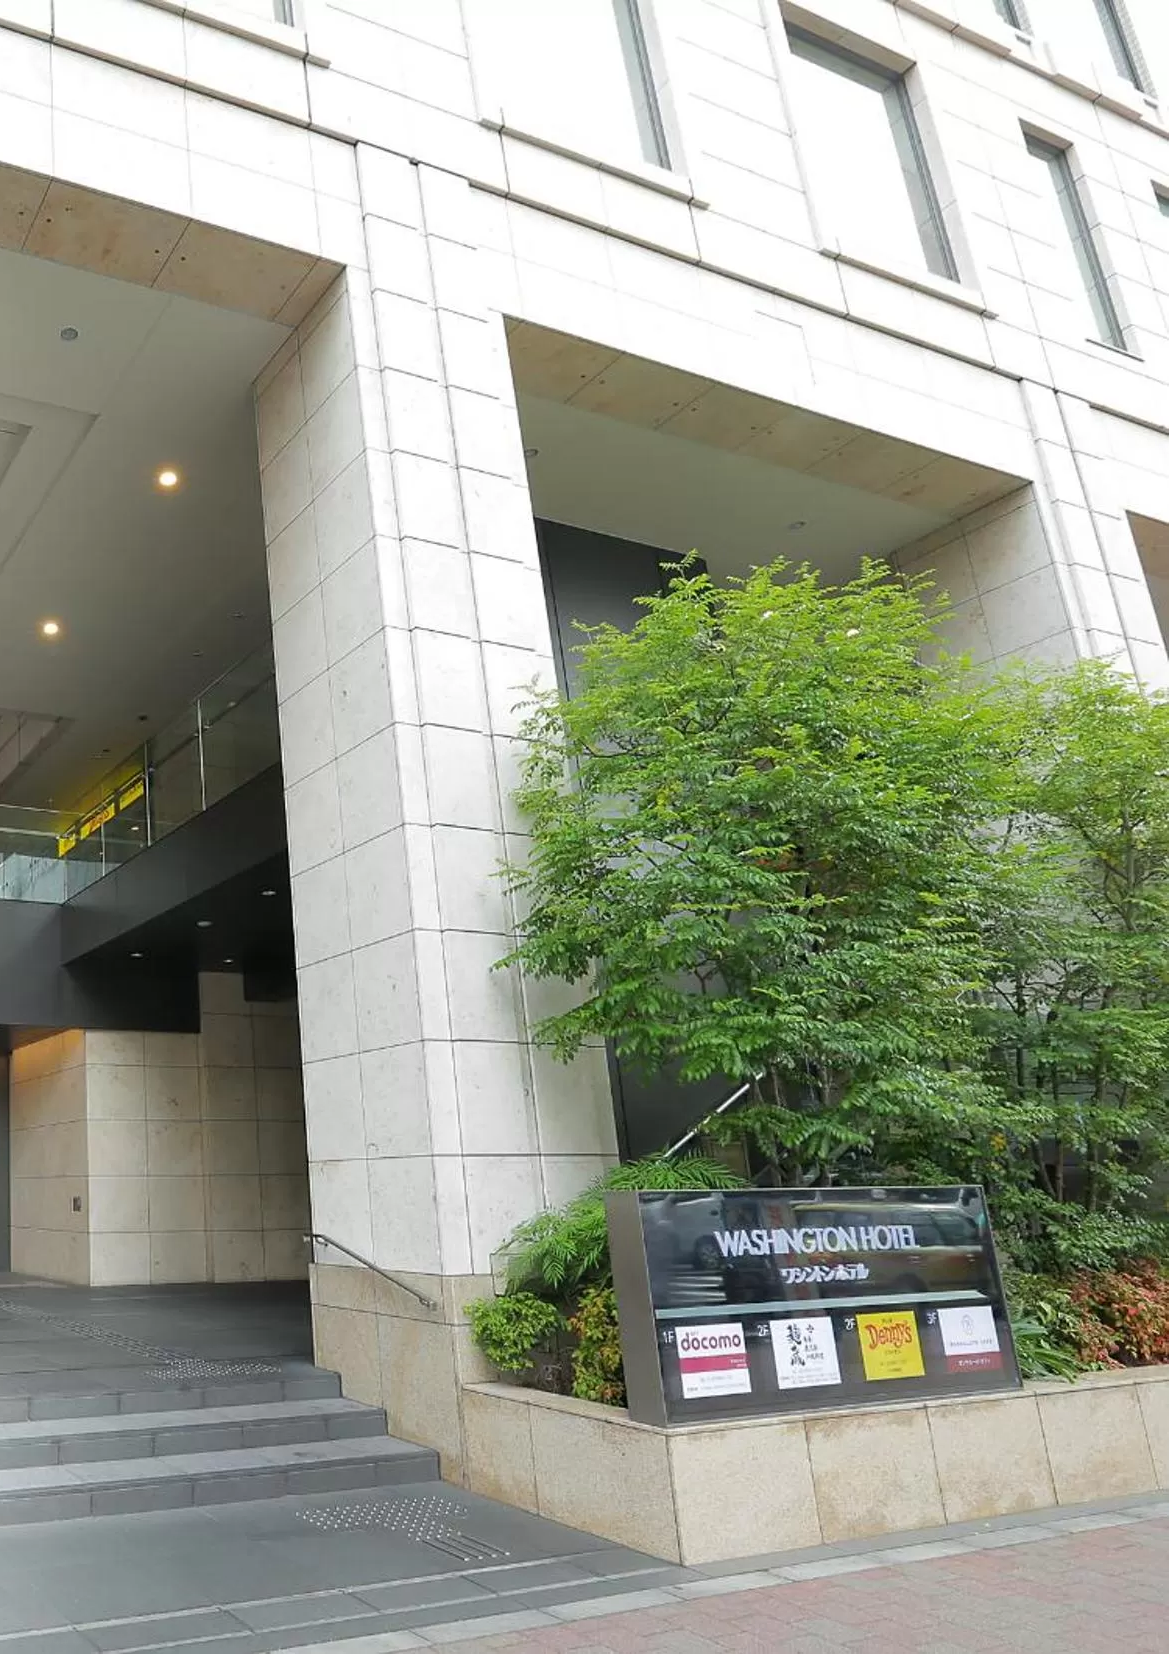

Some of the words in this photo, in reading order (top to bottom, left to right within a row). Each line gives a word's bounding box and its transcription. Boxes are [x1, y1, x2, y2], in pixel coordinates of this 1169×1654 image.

[713, 1226, 860, 1257] WASHINGTON
[859, 1225, 920, 1251] HOTEL
[780, 1262, 870, 1284] ワシントンホテル
[757, 1324, 769, 1337] 2F
[844, 1317, 856, 1331] 2F
[663, 1330, 675, 1344] 1F
[680, 1331, 742, 1352] docomo
[864, 1321, 913, 1350] Denny's
